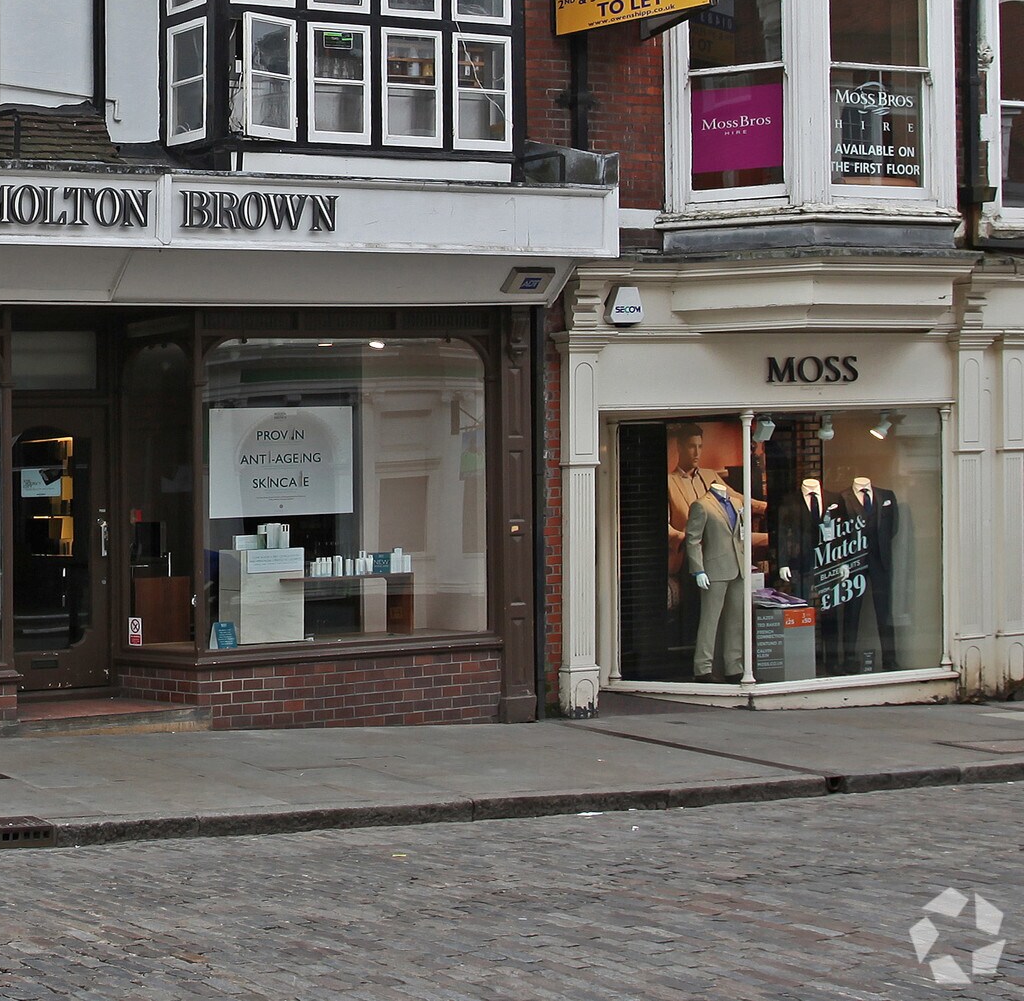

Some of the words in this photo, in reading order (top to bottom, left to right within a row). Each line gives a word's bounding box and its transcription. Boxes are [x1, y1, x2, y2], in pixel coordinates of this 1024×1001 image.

[588, 3, 676, 27] www.owenshipp.co.uk
[597, 1, 624, 17] TO
[877, 91, 914, 107] BROS
[834, 143, 895, 157] AVAILABLE
[898, 146, 915, 157] ON
[831, 161, 850, 173] THE
[854, 162, 882, 174] FIRST
[887, 163, 920, 175] FLOOR
[179, 189, 340, 232] BROWN
[615, 305, 641, 314] SECOM
[766, 356, 859, 383] MOSS
[256, 429, 305, 441] PROVN
[252, 476, 310, 489] SKINCAE
[855, 515, 866, 530] &
[814, 530, 869, 569] Match
[821, 574, 867, 611] £139
